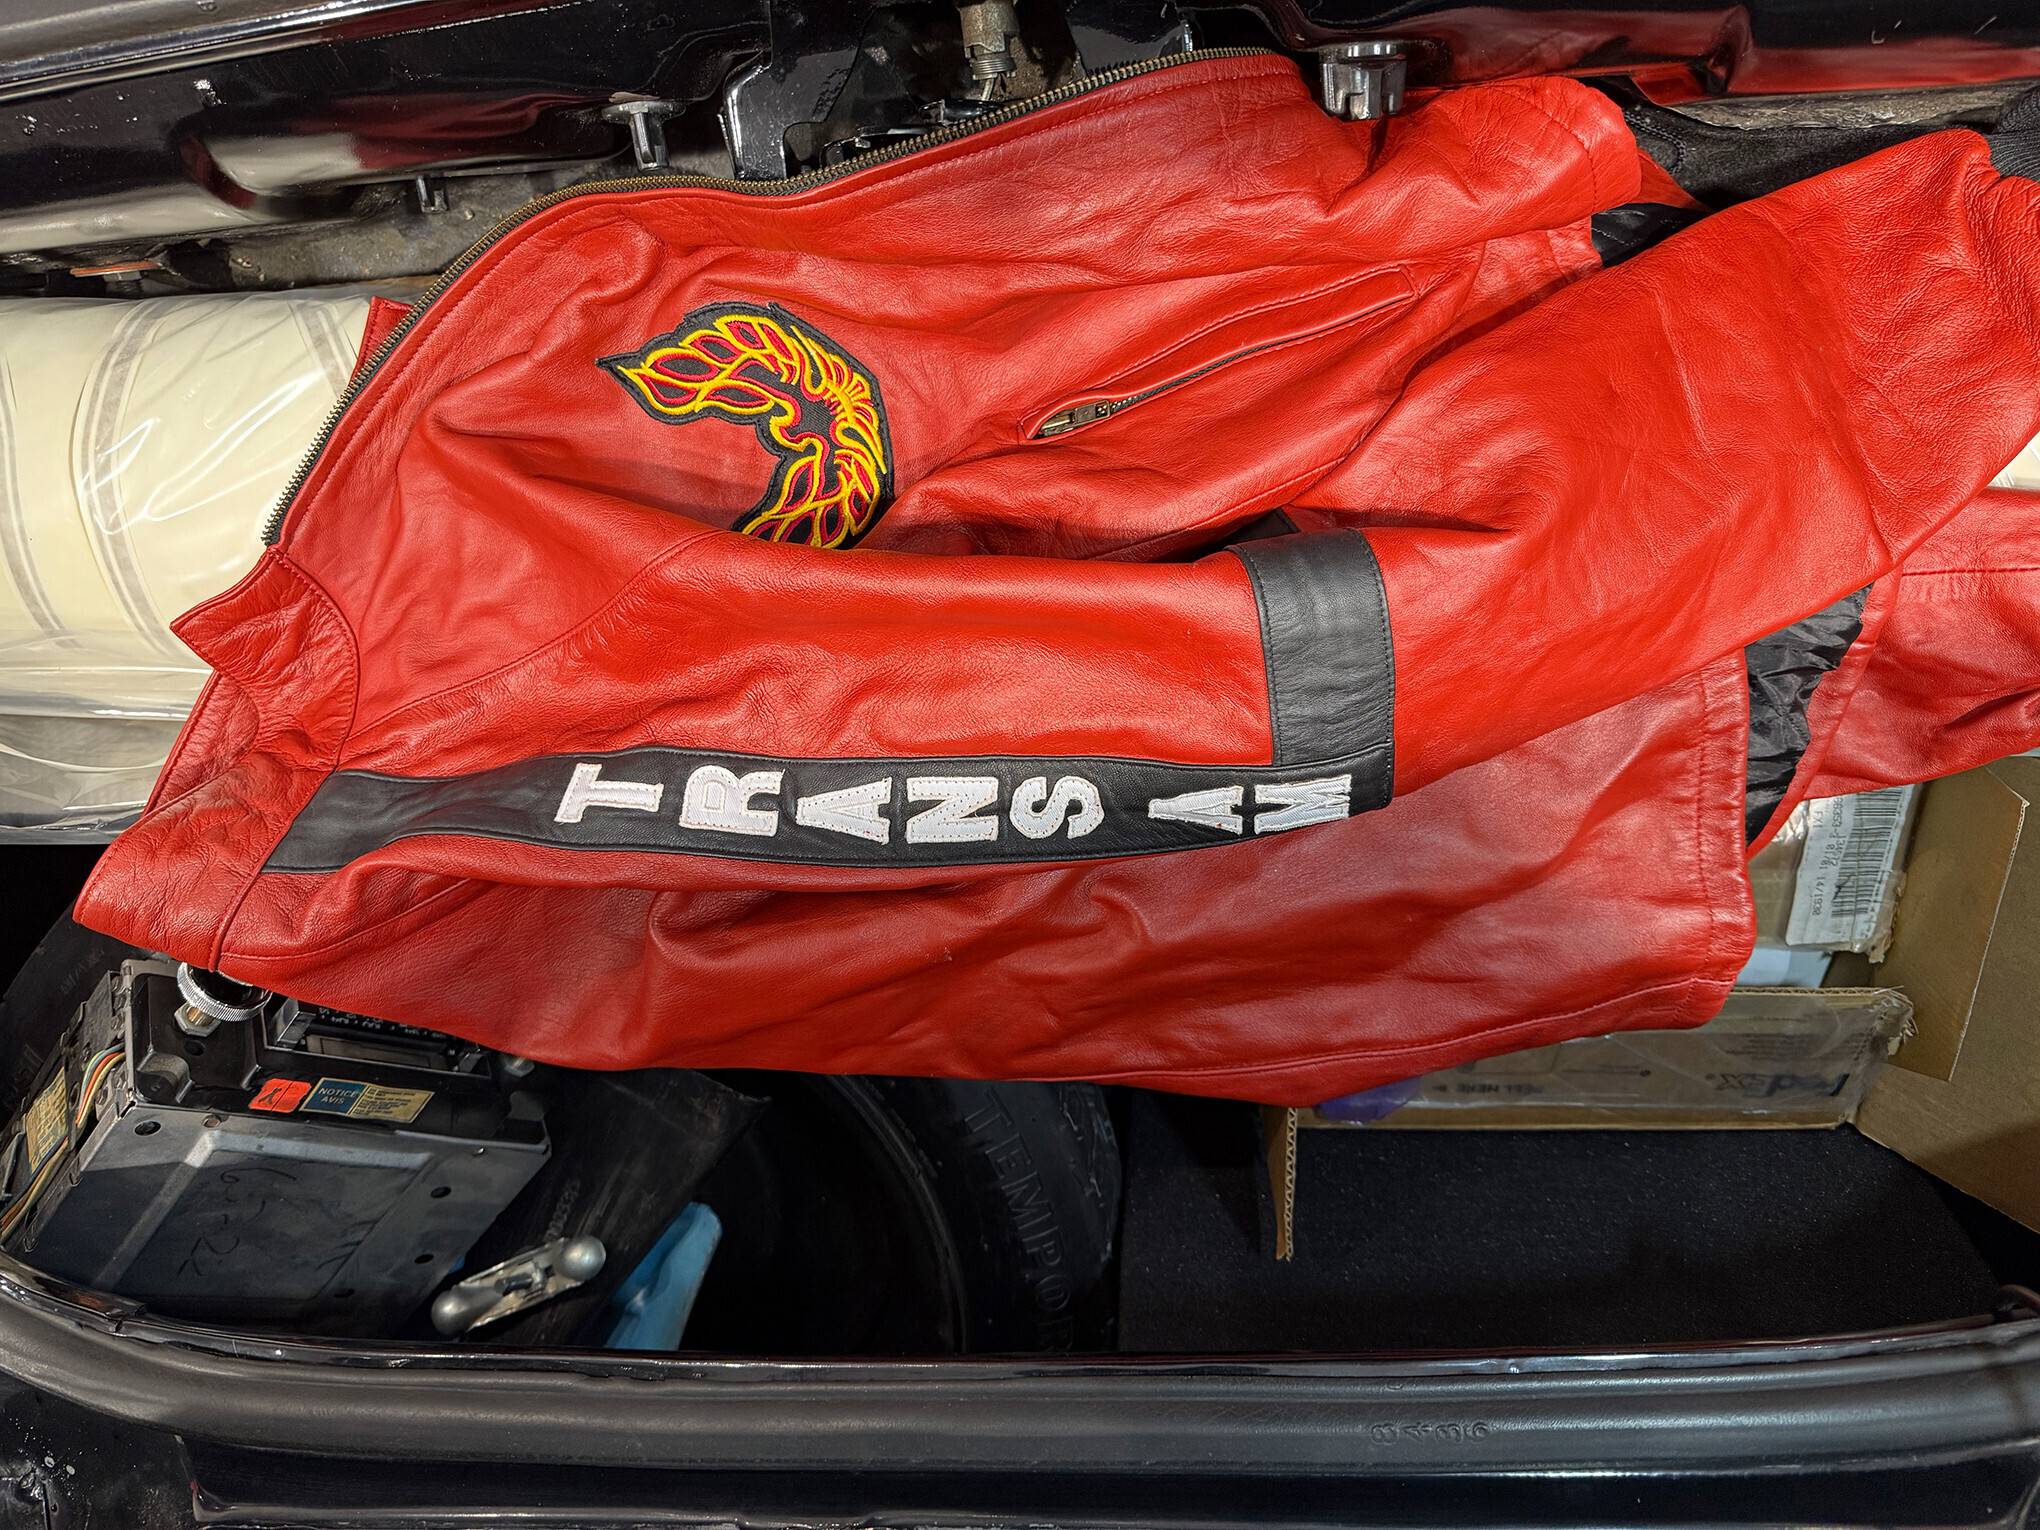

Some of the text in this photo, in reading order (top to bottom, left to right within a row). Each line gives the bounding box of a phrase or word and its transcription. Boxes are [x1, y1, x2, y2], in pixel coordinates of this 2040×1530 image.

[553, 762, 1354, 846] TRANS AM
[318, 1086, 359, 1099] NOTICE
